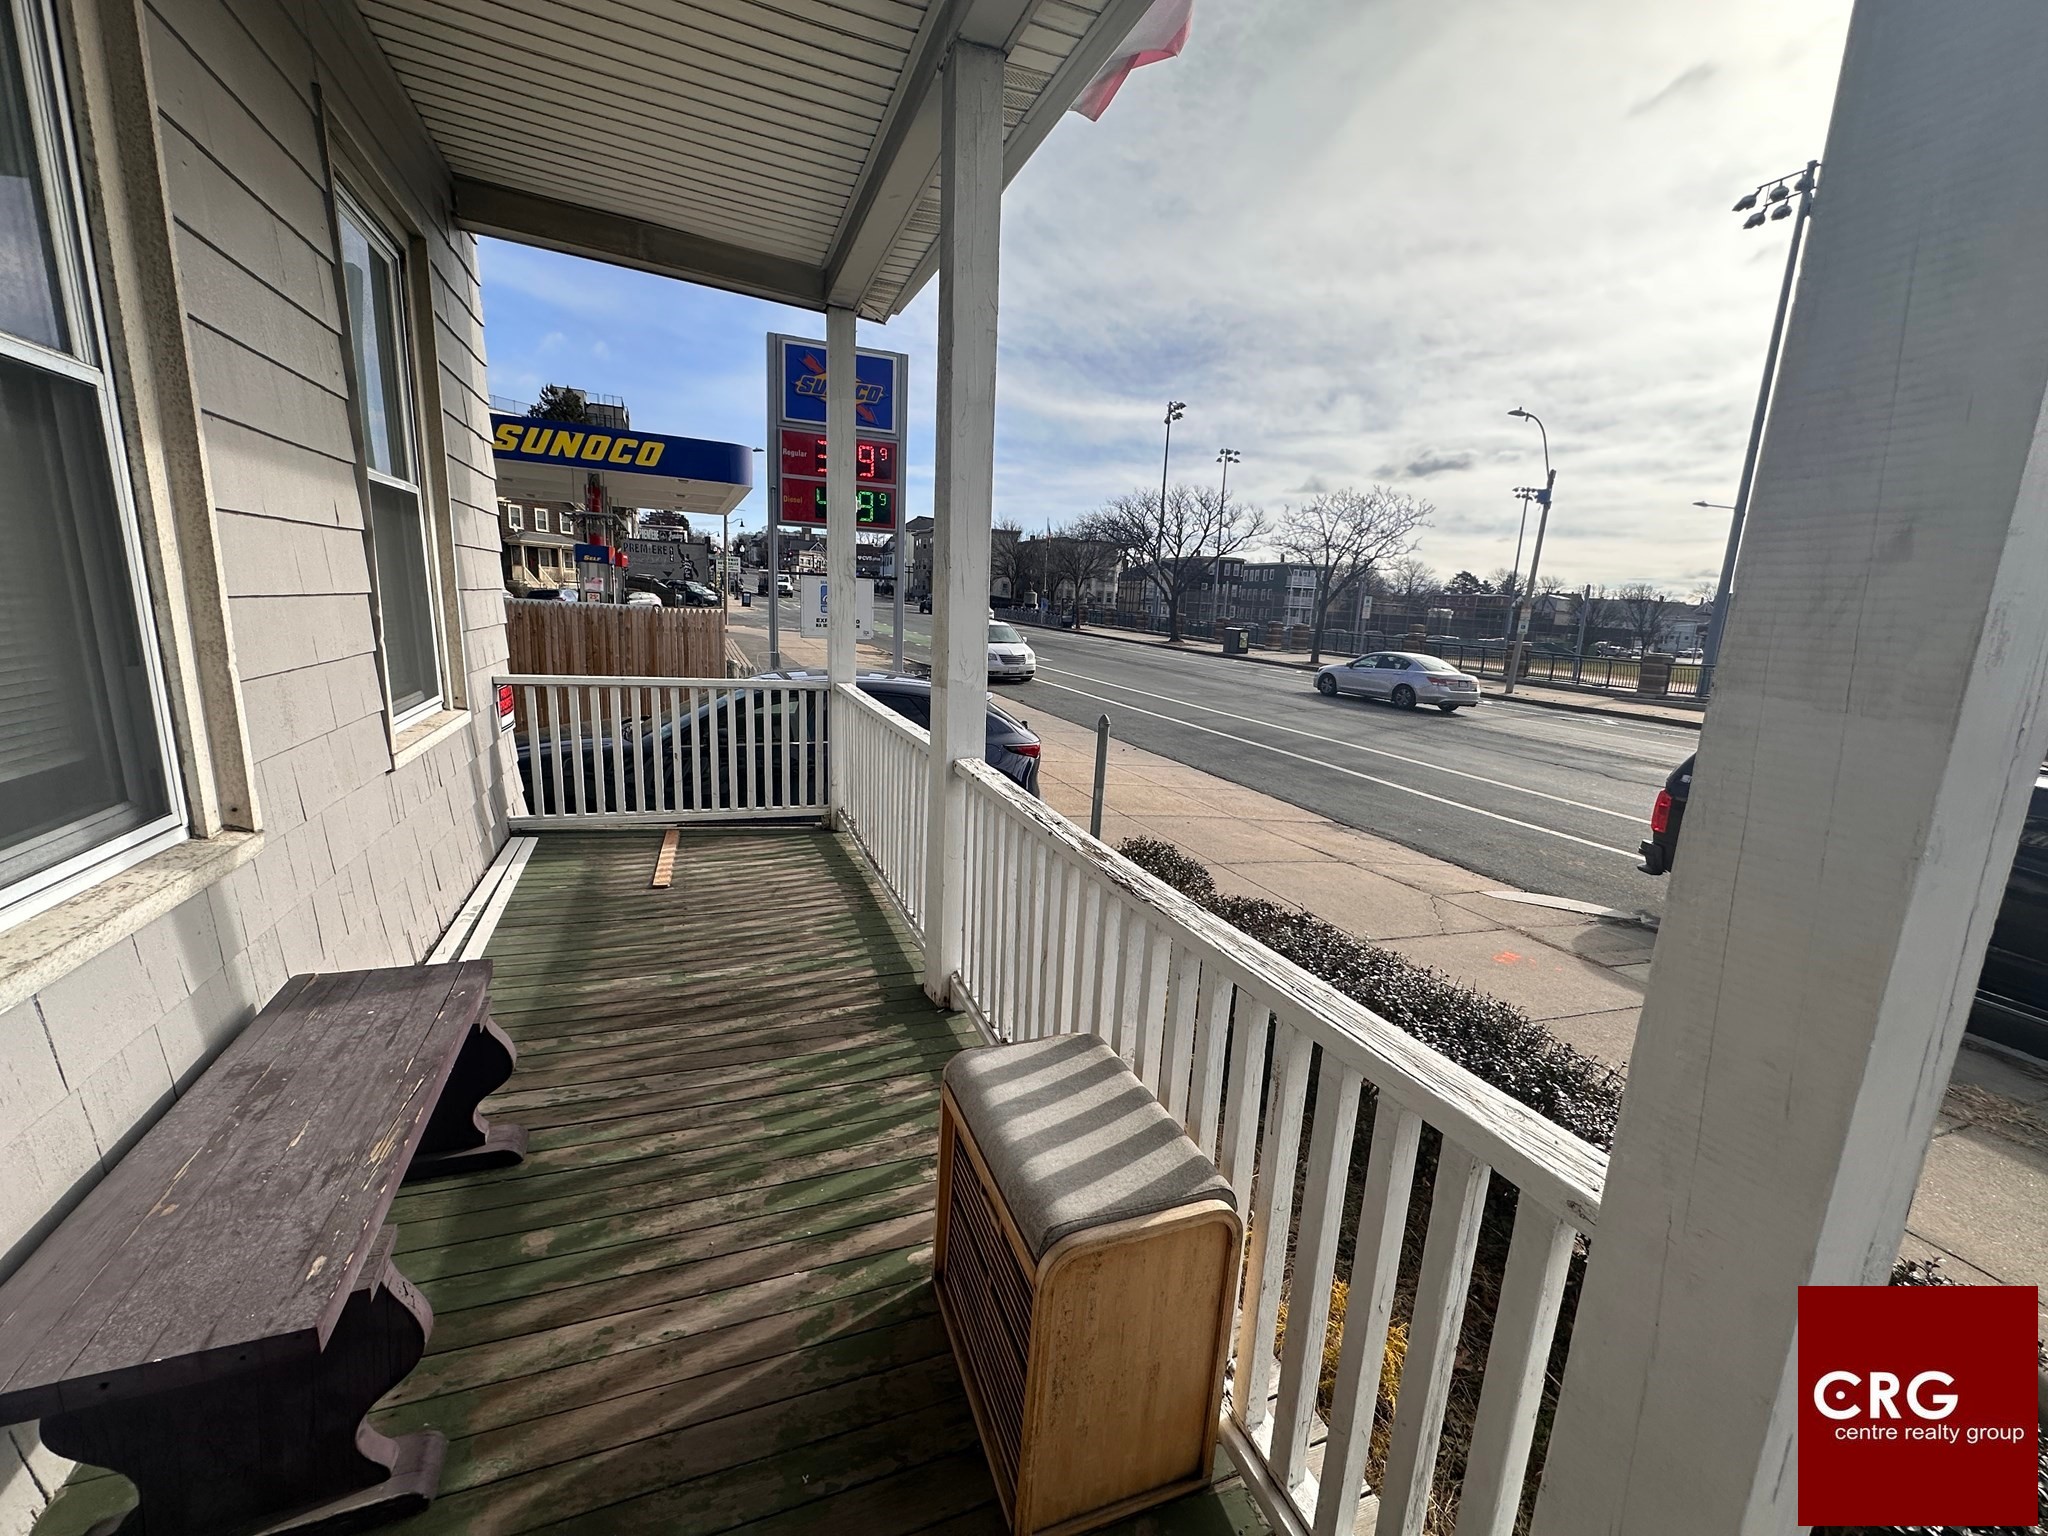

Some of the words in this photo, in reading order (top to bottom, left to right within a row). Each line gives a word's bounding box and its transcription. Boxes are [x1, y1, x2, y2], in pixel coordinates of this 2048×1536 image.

[799, 376, 881, 402] SUCO
[492, 423, 666, 467] SUNOCO
[782, 447, 807, 458] Regular
[783, 495, 803, 504] Diesel
